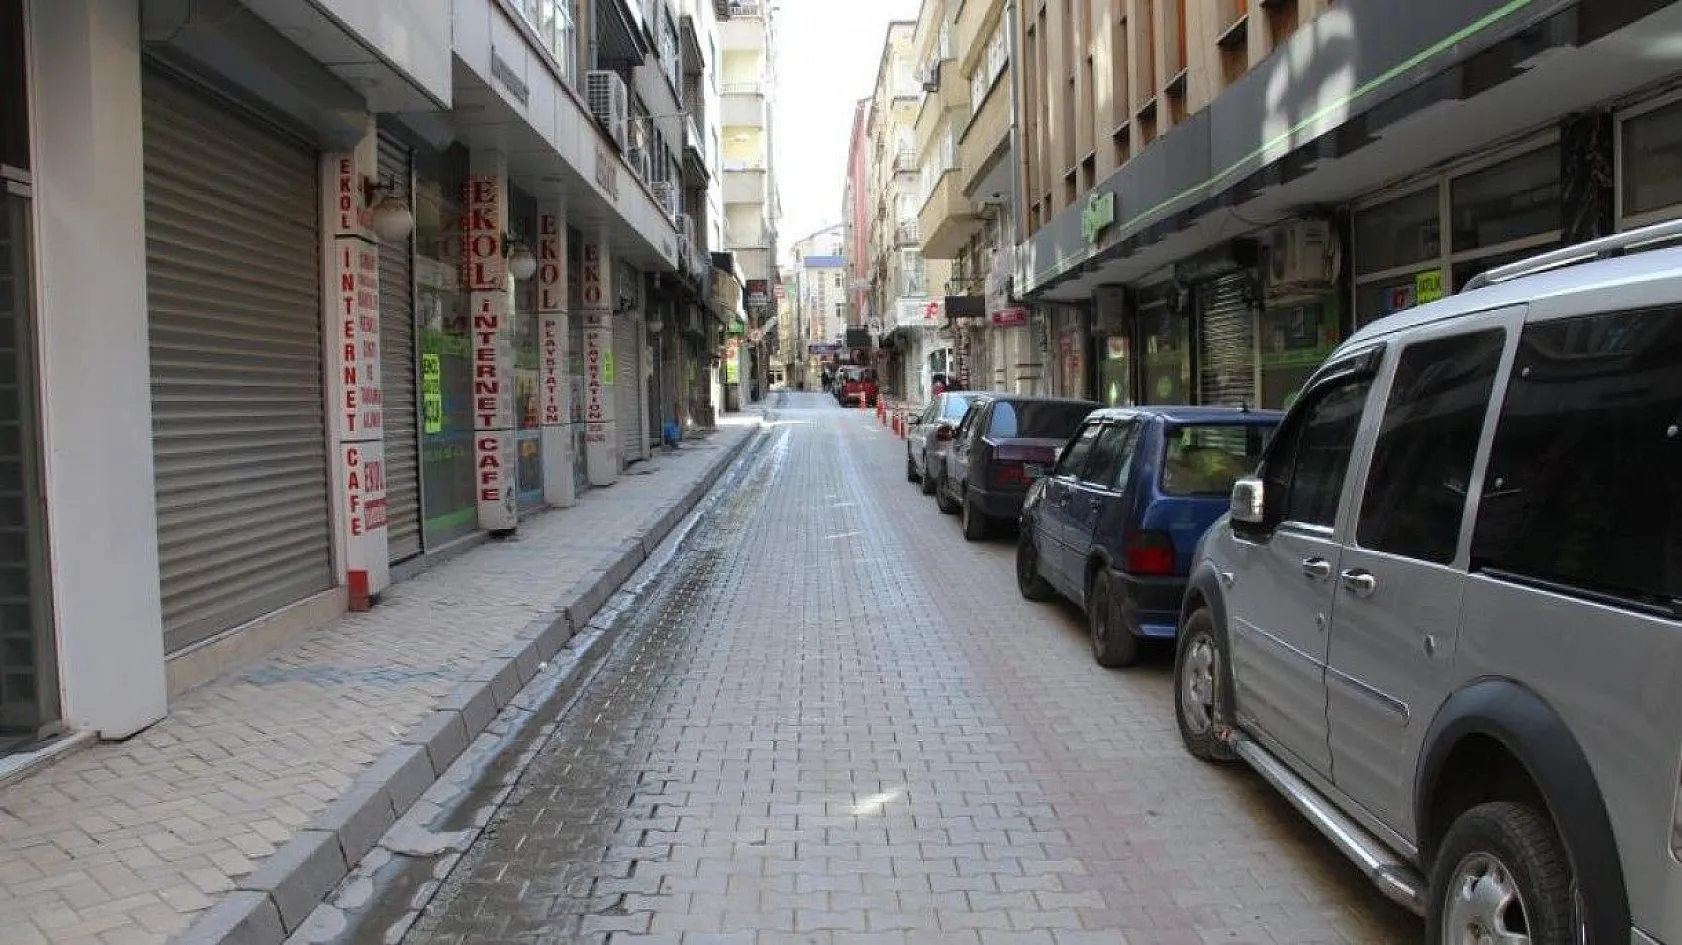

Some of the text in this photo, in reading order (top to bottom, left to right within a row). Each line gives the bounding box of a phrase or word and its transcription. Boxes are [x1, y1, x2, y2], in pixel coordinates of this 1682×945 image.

[471, 181, 498, 286] EKOL
[540, 214, 559, 309] EKOL
[340, 159, 351, 229] EKOL
[347, 449, 362, 537] CAFE
[478, 438, 500, 501] CAFE
